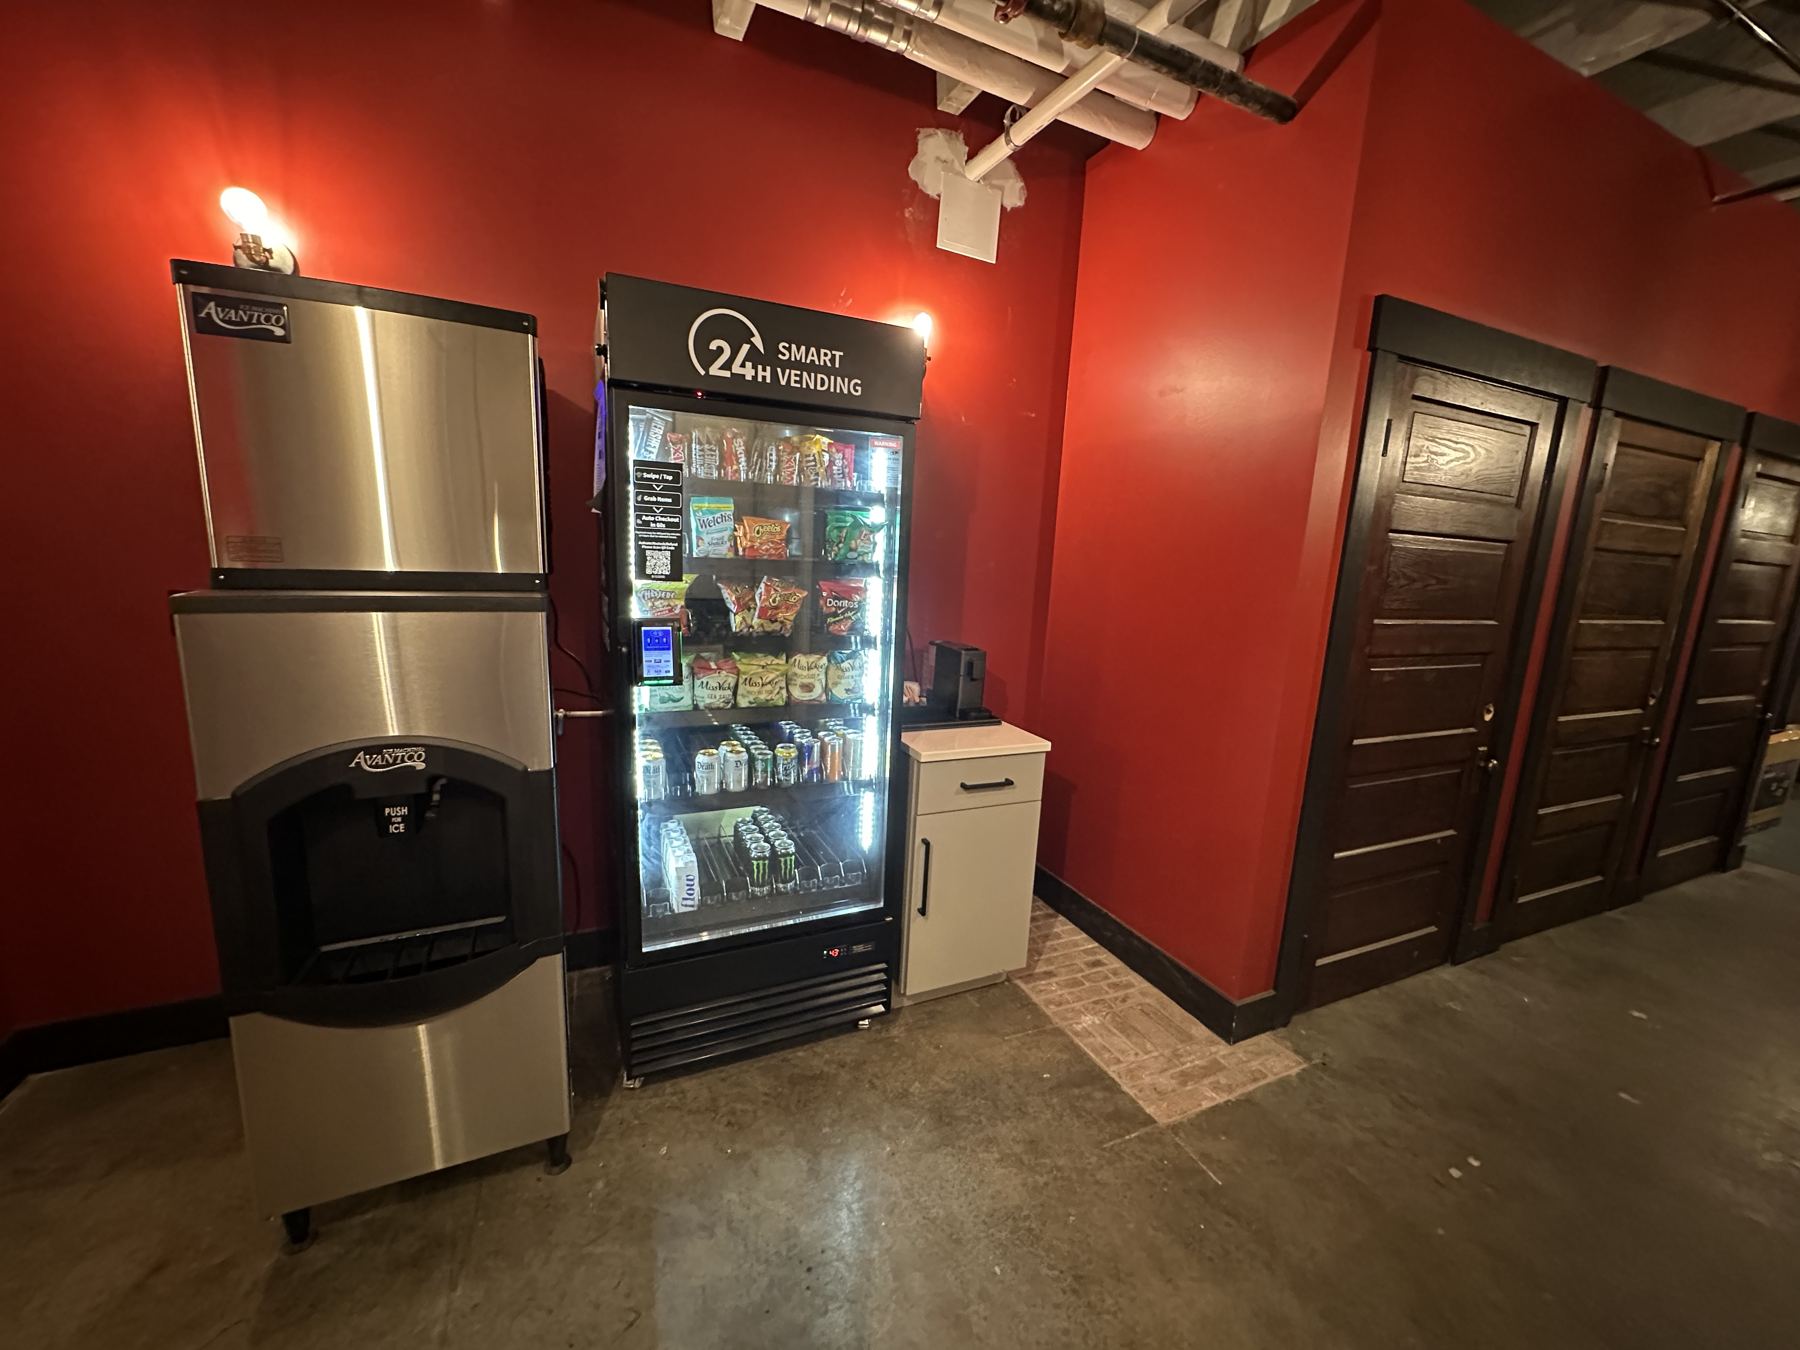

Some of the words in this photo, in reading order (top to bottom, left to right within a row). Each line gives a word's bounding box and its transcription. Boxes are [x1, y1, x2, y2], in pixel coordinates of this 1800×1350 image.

[198, 301, 285, 333] AVANTCO
[777, 341, 844, 368] SMART
[776, 367, 862, 396] VENDING
[698, 512, 733, 530] Welch's
[826, 598, 859, 608] Doritos
[349, 750, 426, 771] AVANTCO
[384, 806, 408, 816] PUSH
[389, 823, 405, 833] ICE
[680, 874, 695, 908] flow
